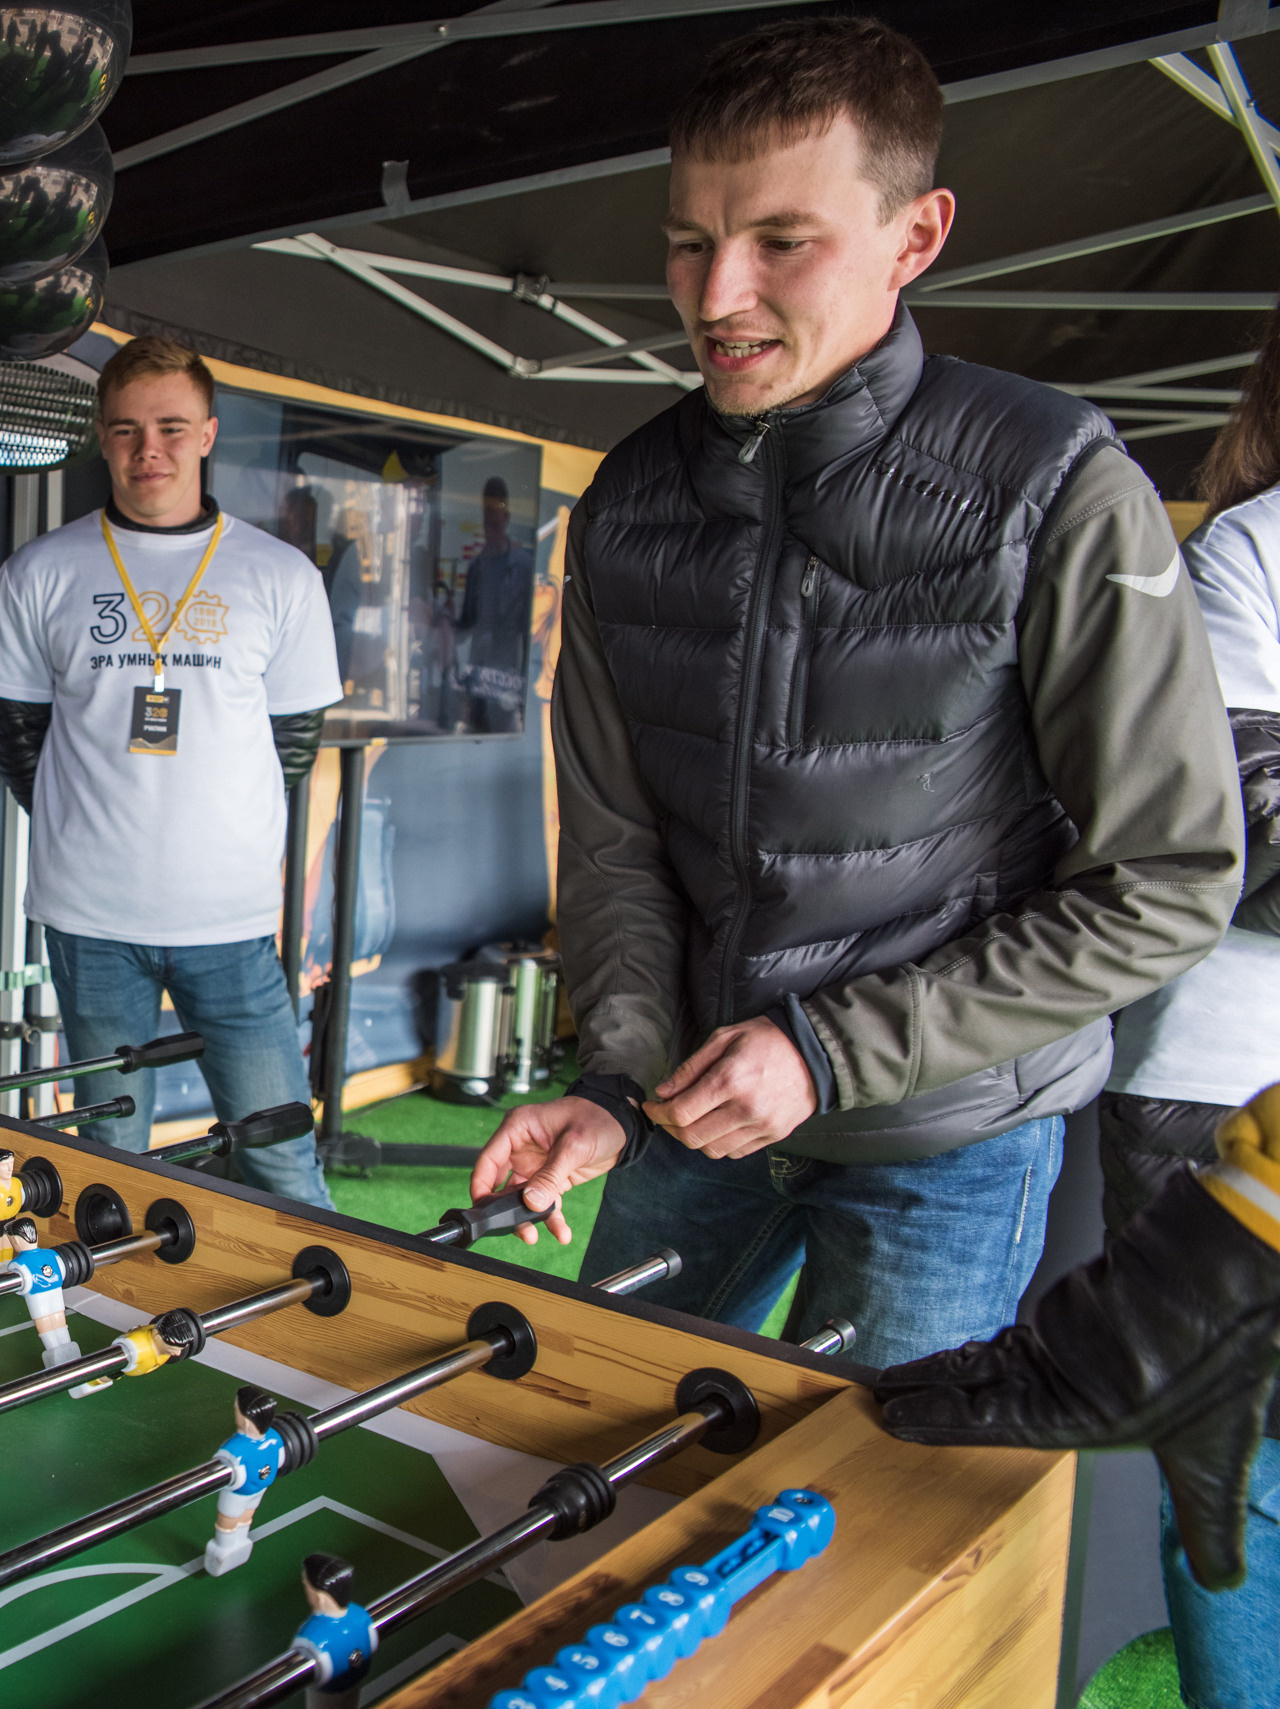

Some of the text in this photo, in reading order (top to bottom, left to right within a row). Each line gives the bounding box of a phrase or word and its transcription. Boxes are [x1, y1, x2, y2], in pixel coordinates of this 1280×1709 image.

[90, 654, 114, 670] ЭРА
[172, 654, 222, 669] МАШИН
[658, 1591, 685, 1606] 8
[630, 1609, 656, 1625] 7
